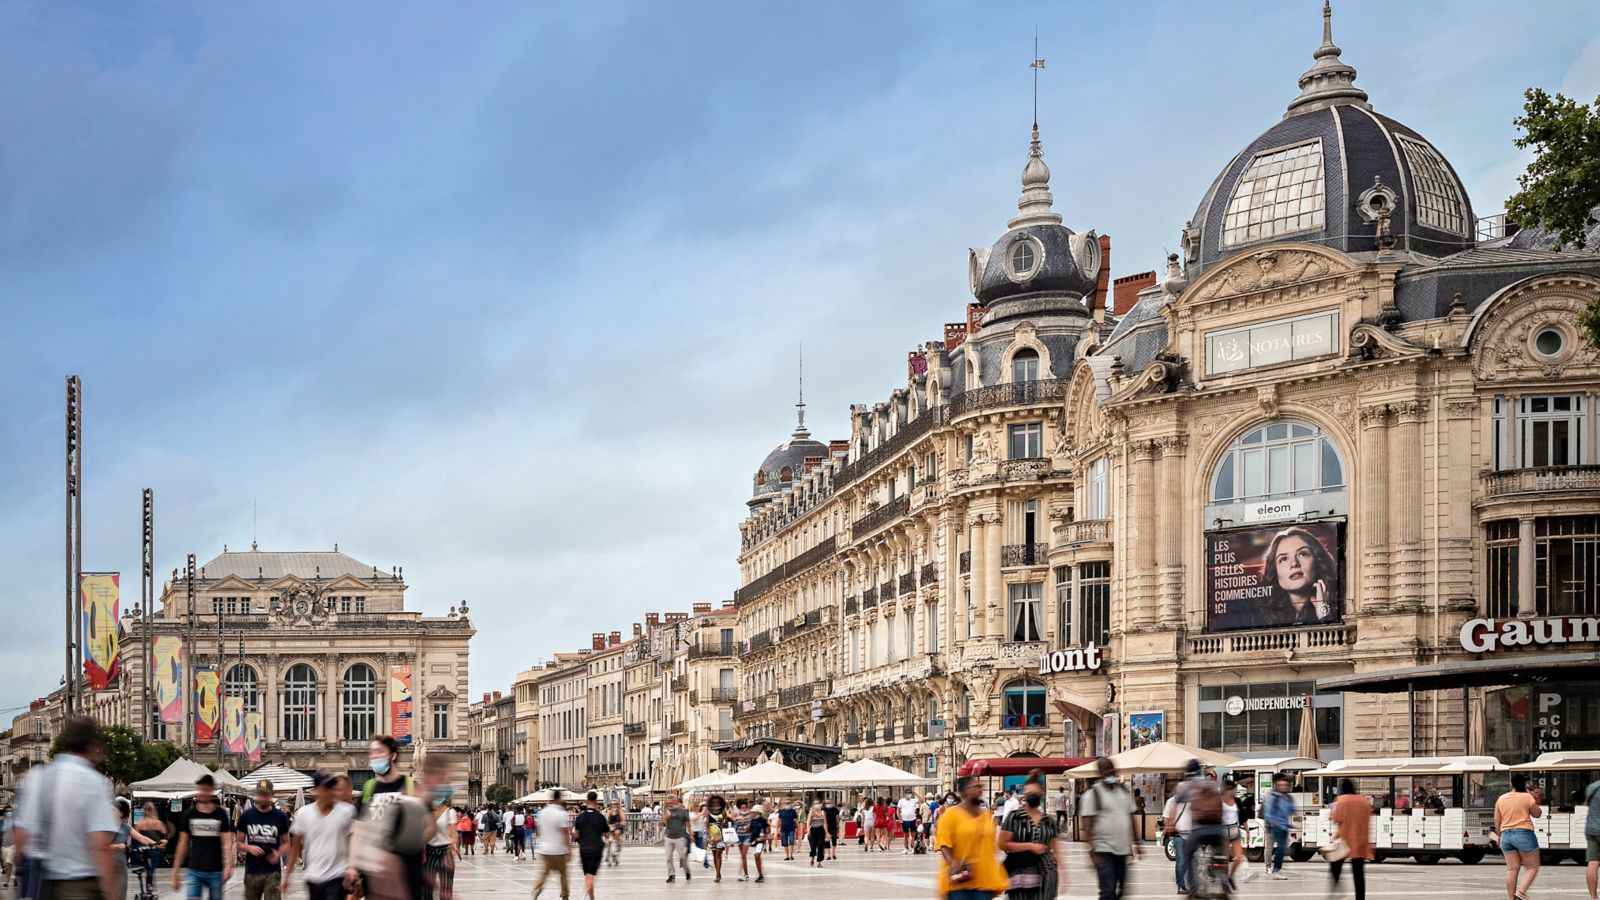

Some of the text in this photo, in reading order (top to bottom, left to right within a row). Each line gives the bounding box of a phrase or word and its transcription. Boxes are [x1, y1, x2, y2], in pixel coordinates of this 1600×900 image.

[1248, 331, 1323, 355] NOTAIRES
[1257, 504, 1291, 514] eleom
[1214, 540, 1229, 552] LES
[1214, 552, 1236, 564] PLUS
[1214, 563, 1245, 577] BELLES
[1214, 575, 1258, 589] HISTOIRES
[1214, 585, 1273, 602] COMMENCENT
[1214, 602, 1227, 614] ICI
[1459, 617, 1600, 653] Gaum
[1039, 640, 1101, 675] mont
[1243, 696, 1306, 711] INDEPENDENCE
[1004, 714, 1043, 729] CIC
[246, 824, 278, 837] NASA
